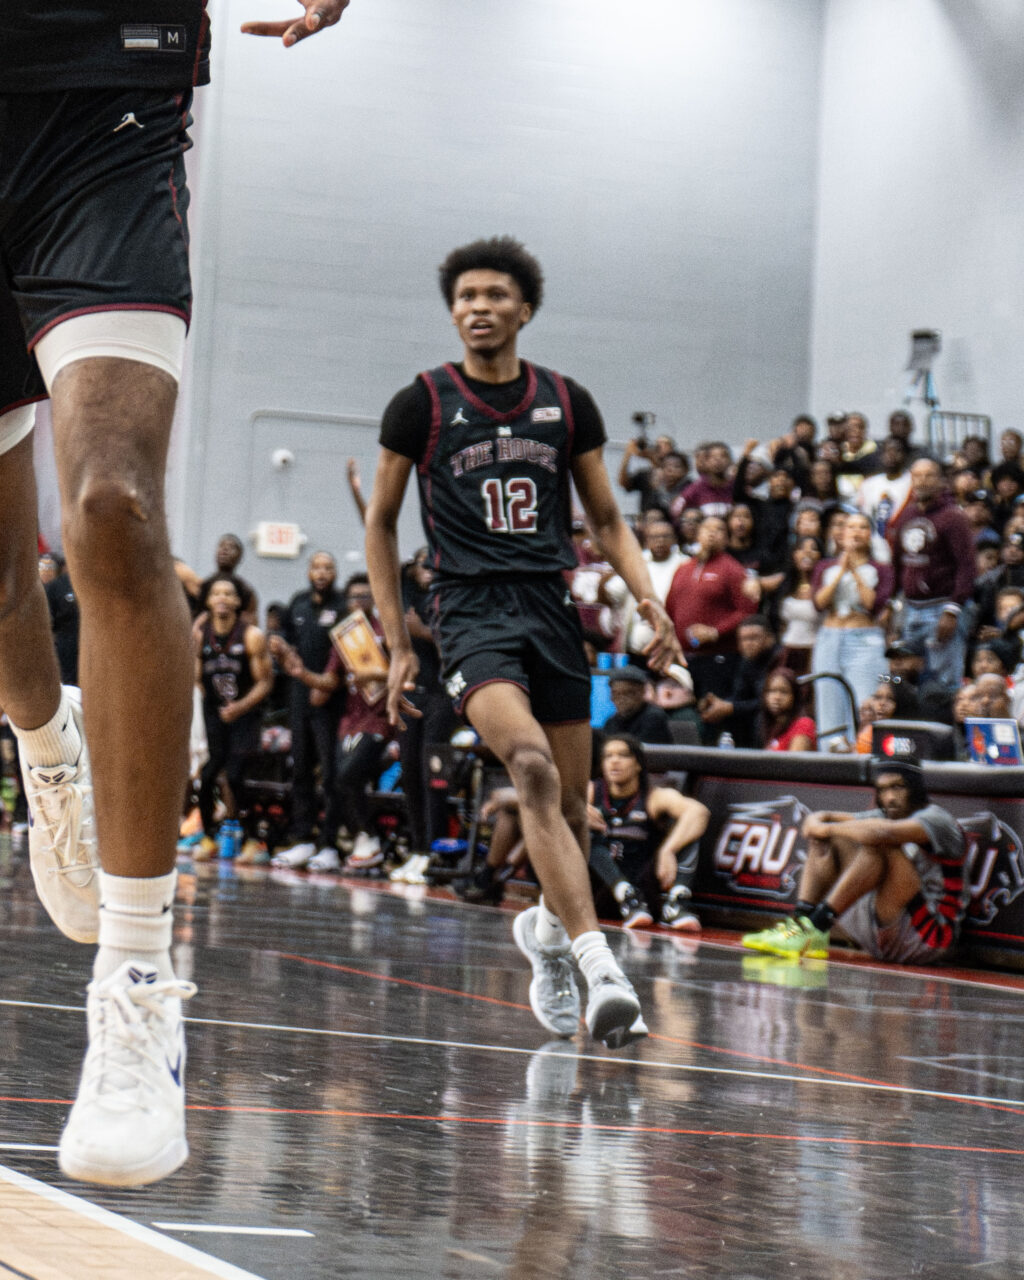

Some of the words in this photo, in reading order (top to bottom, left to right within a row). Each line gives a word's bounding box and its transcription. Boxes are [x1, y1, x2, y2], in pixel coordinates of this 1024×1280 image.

[167, 31, 179, 45] M
[450, 440, 493, 477] THE
[481, 477, 538, 534] 12
[716, 817, 798, 875] CAU
